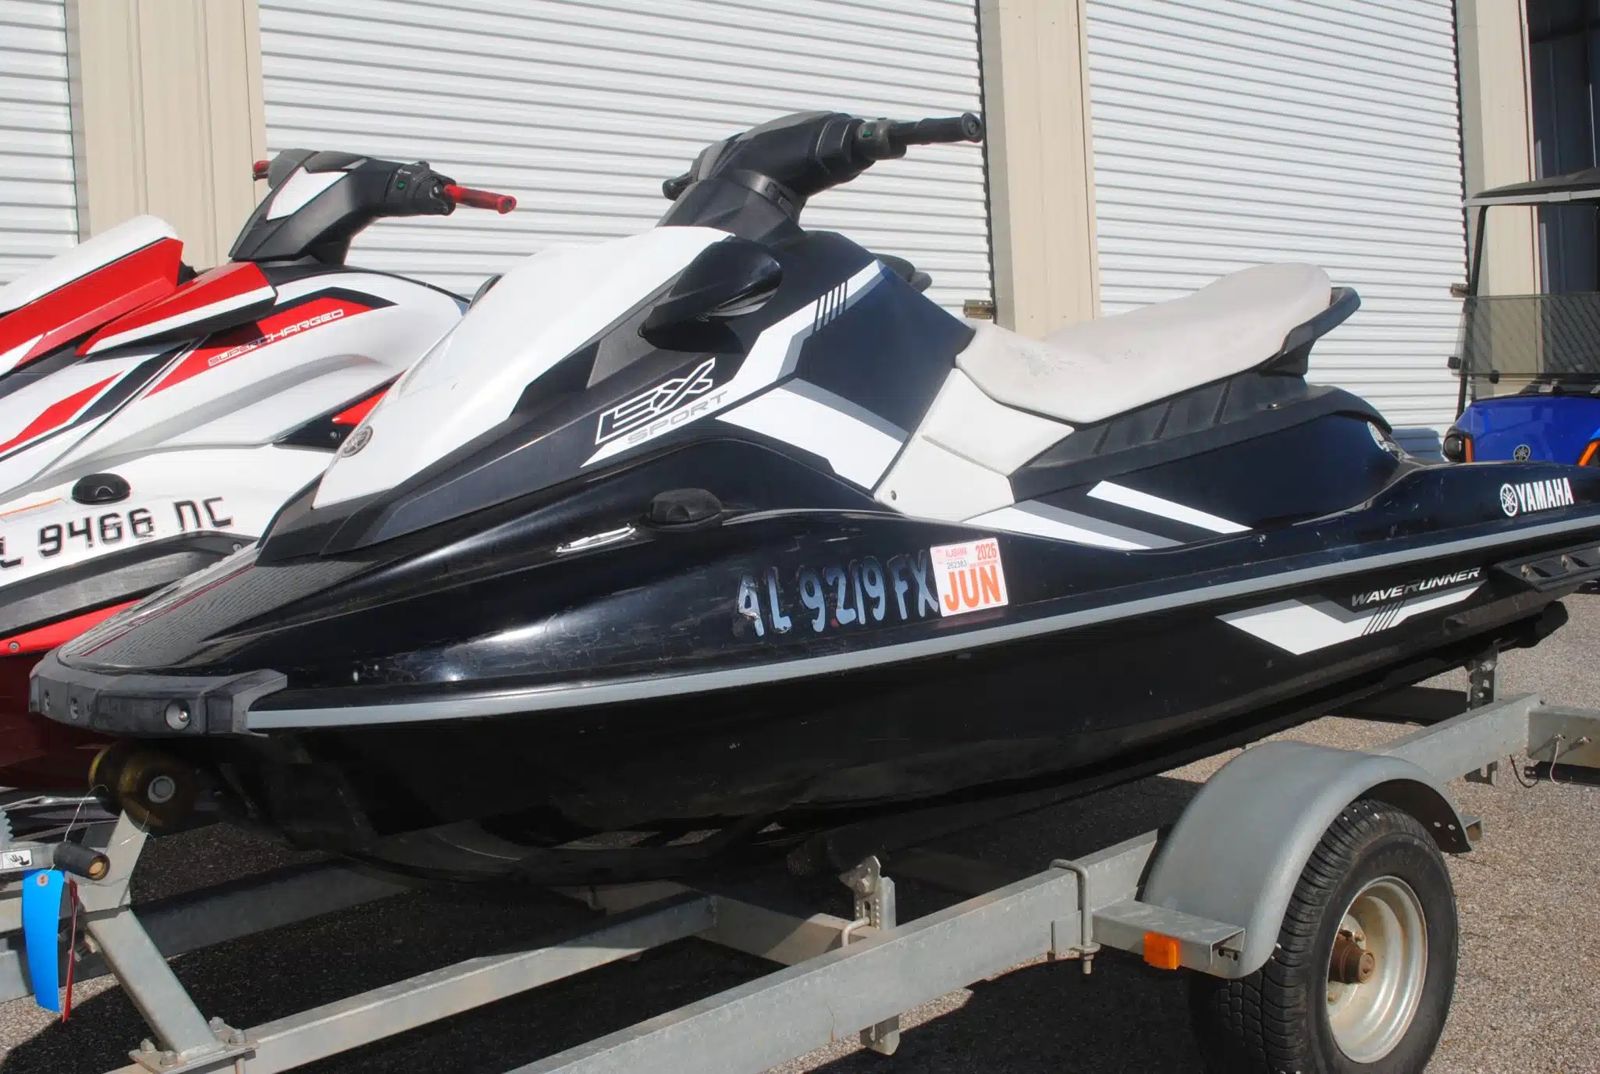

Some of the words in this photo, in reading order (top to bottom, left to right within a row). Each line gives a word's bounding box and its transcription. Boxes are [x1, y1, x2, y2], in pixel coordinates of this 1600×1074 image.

[208, 308, 344, 367] SUPERCHARGED
[595, 357, 716, 445] EX
[627, 390, 728, 445] SPORT
[1516, 477, 1575, 513] YAMAHA
[38, 507, 155, 558] 9466
[976, 543, 997, 560] 2026
[737, 566, 792, 637] AL
[799, 556, 887, 633] 9219
[889, 550, 939, 621] FX
[944, 565, 1001, 612] JUN
[1351, 567, 1481, 607] WAVERUNNER
